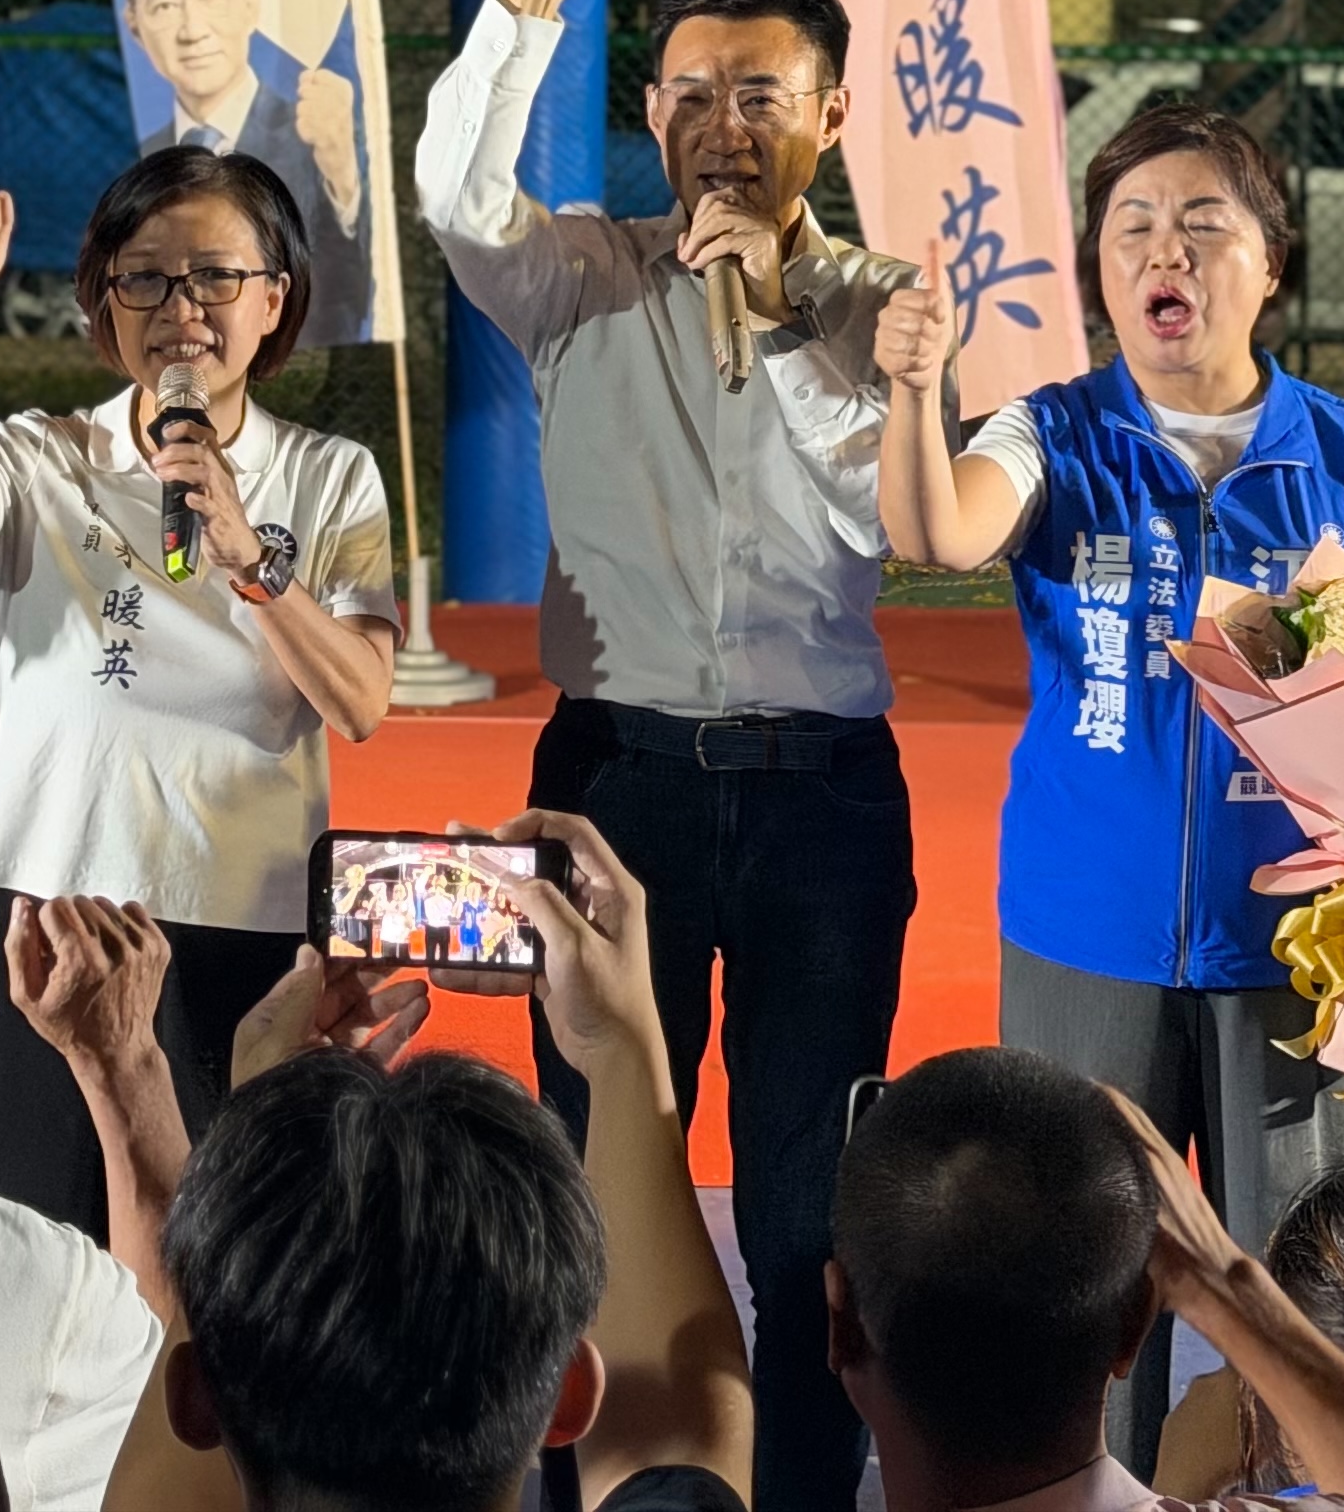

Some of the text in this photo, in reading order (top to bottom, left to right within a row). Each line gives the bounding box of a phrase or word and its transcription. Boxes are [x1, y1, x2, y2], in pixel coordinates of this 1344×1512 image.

[1070, 531, 1134, 754] 楊瓊瓔
[1144, 543, 1179, 681] 立法委員
